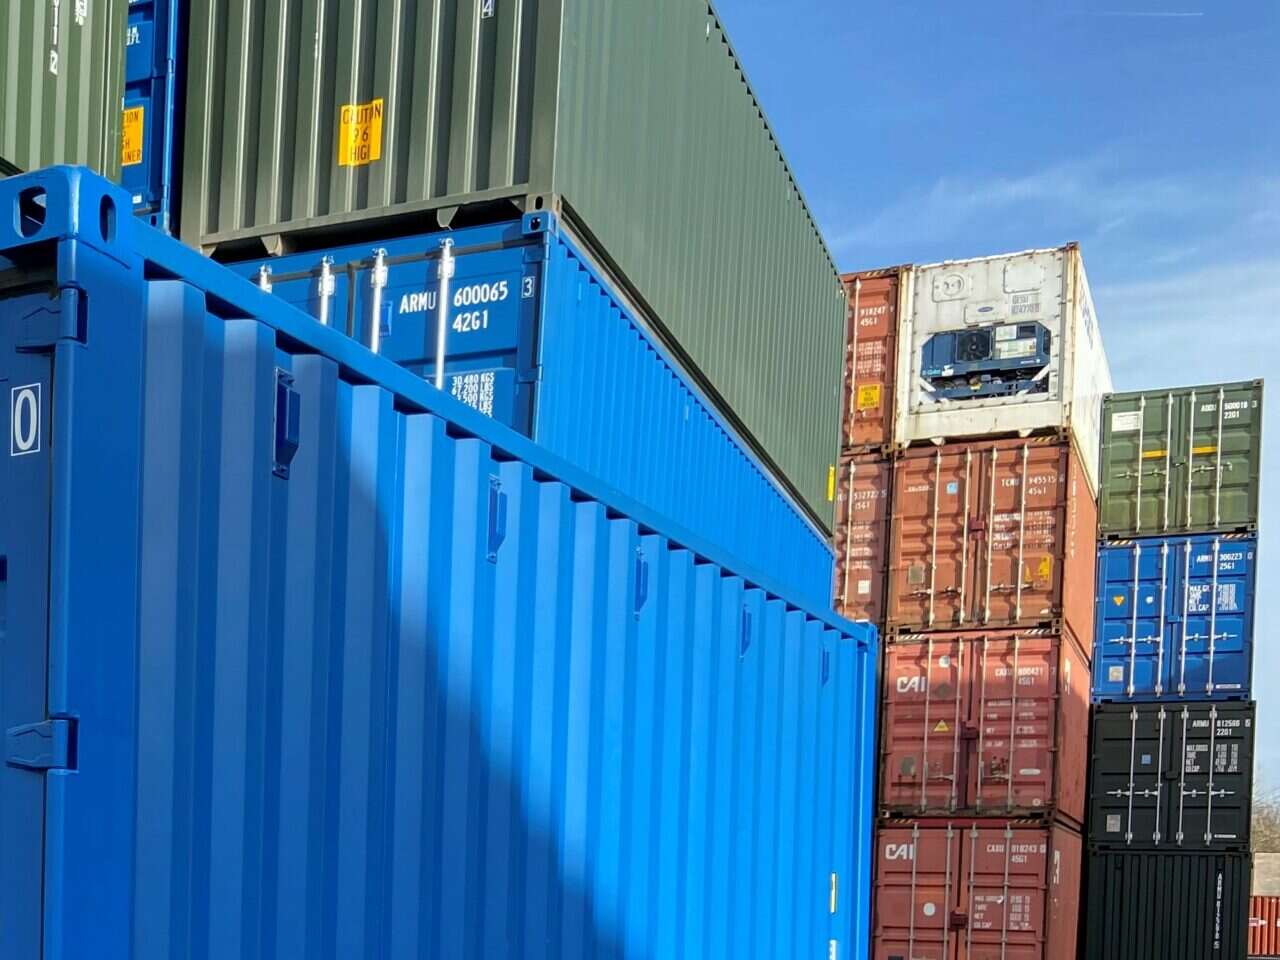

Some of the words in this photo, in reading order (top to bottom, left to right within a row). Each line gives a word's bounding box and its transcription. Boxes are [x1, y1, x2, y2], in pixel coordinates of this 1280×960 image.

[399, 291, 437, 314] ARMU
[453, 280, 509, 307] 600065
[452, 309, 489, 333] 42G1
[12, 385, 39, 454] 0
[896, 676, 927, 693] CAI
[885, 843, 915, 860] CAI
